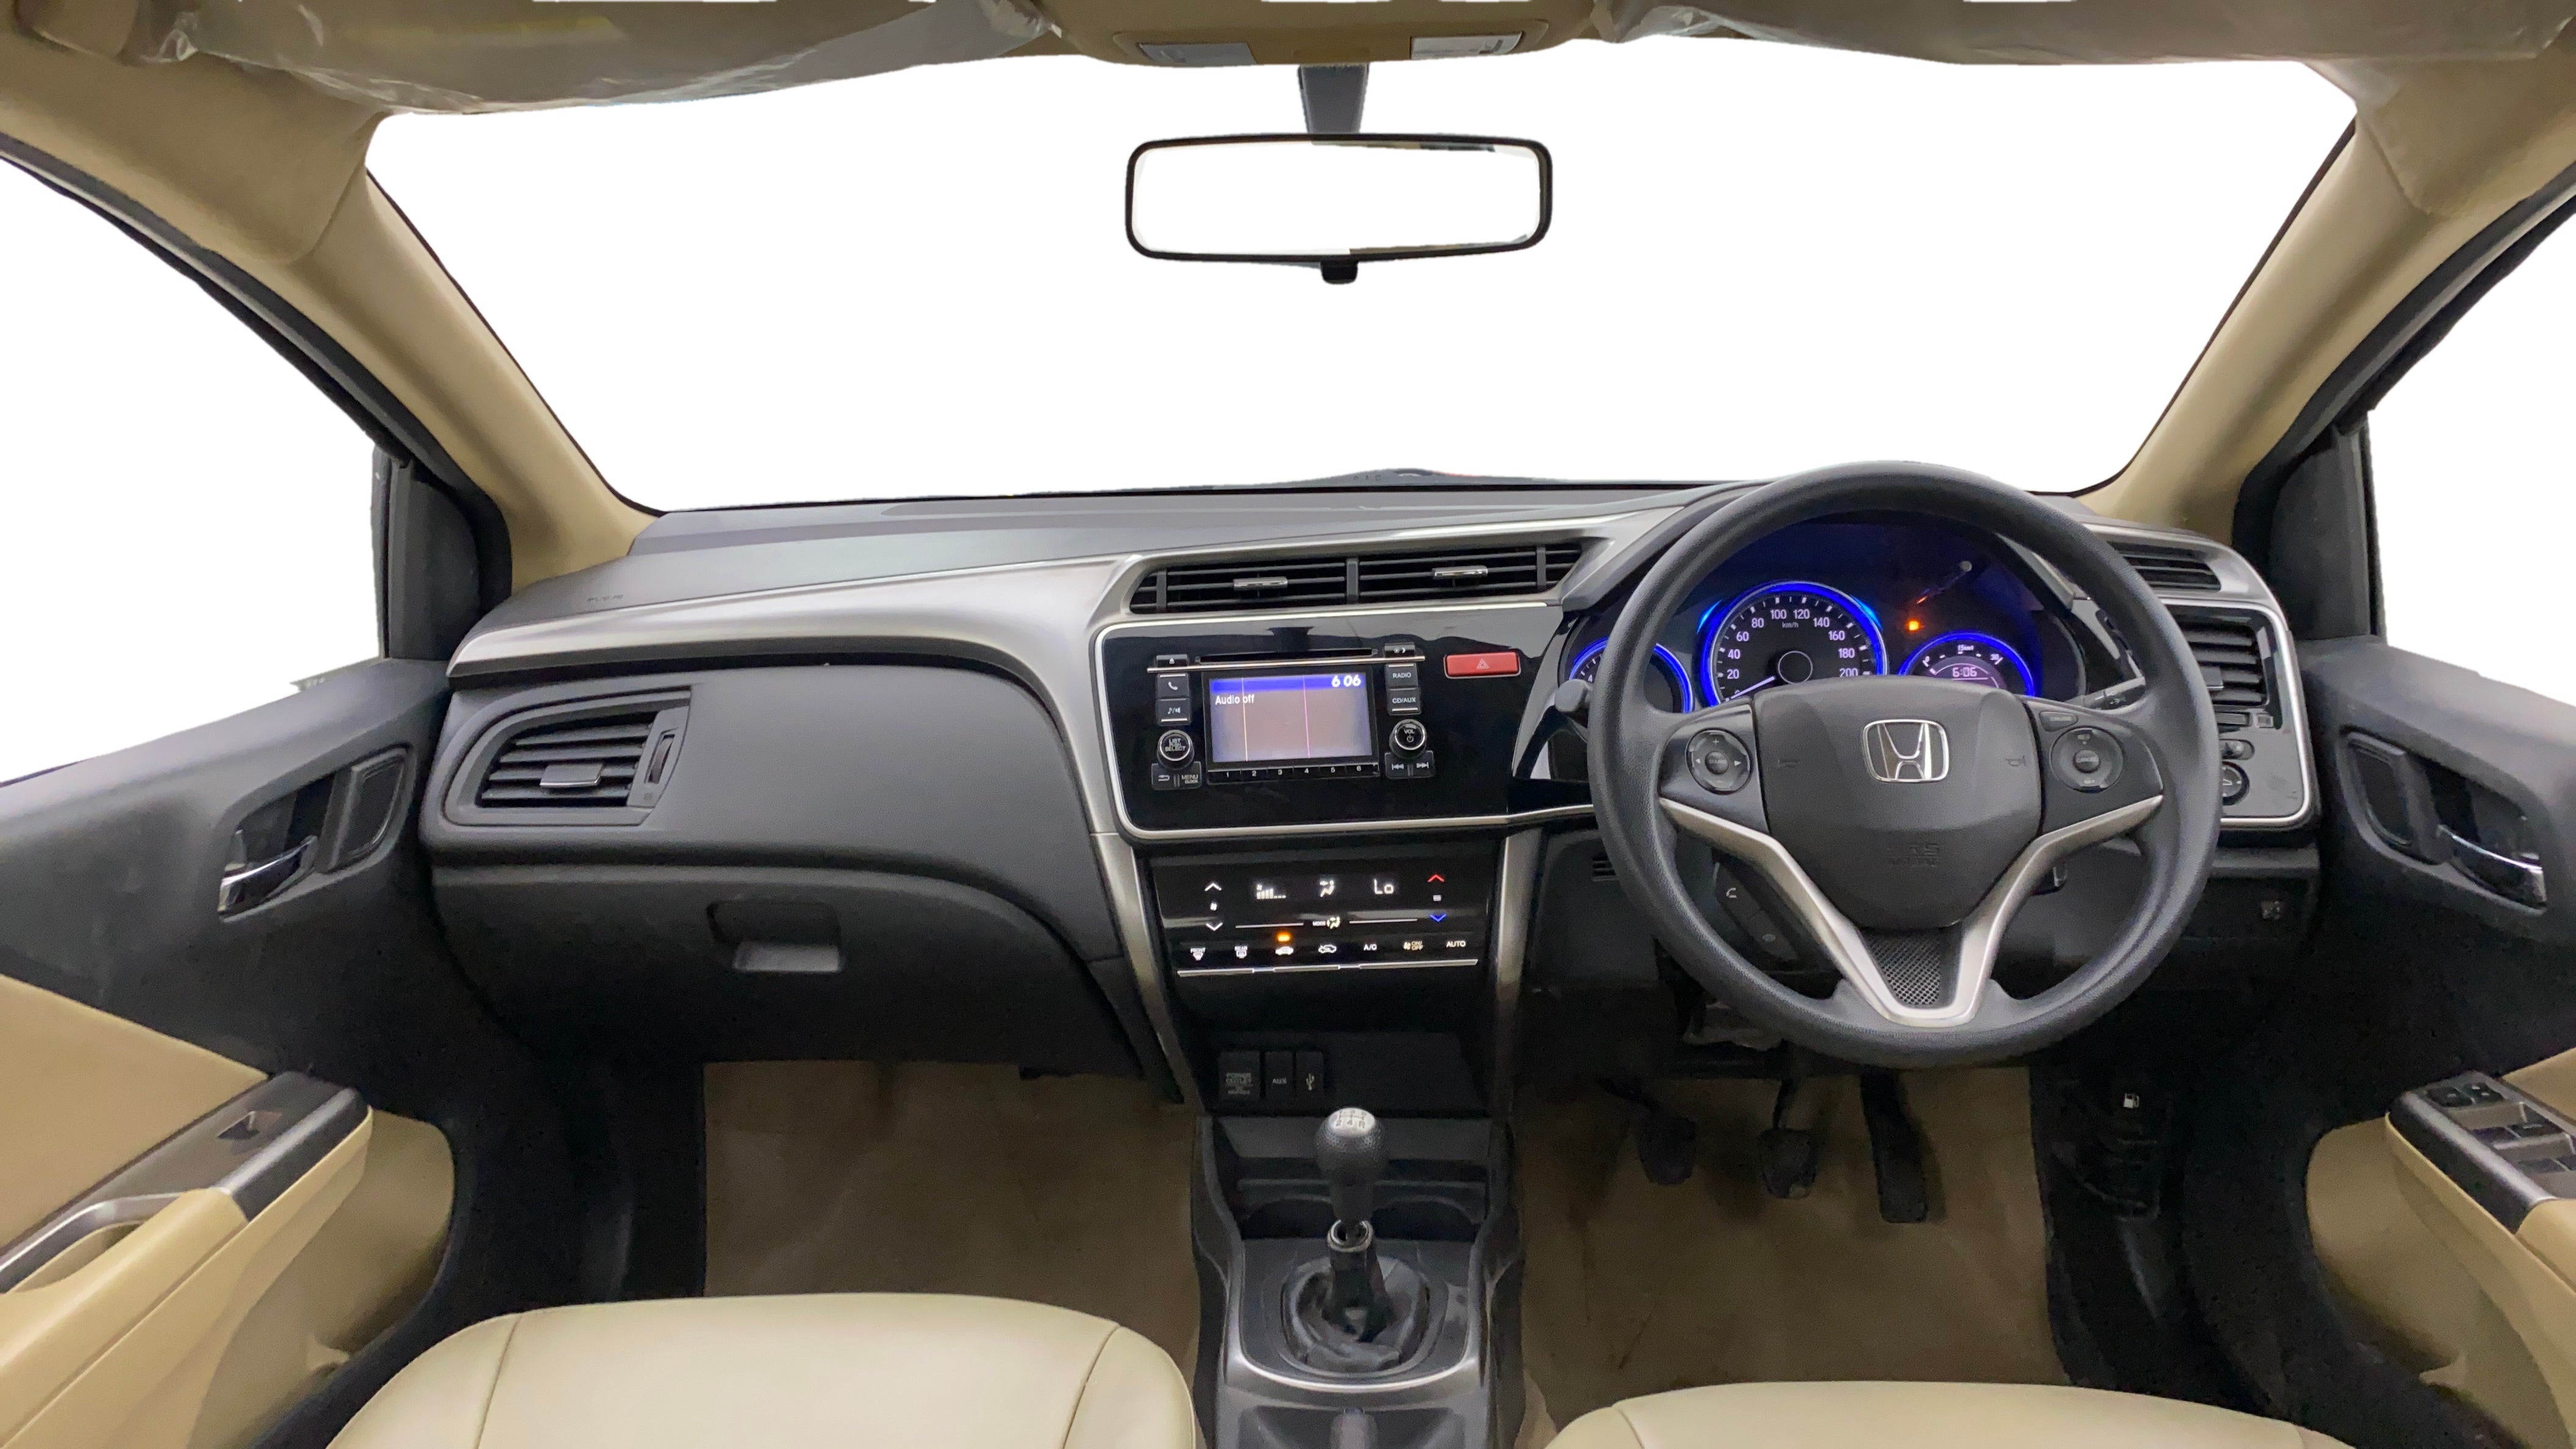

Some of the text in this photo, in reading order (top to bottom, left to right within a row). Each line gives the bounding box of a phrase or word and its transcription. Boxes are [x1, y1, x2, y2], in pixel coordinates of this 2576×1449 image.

[1770, 609, 1787, 620] 100
[1794, 609, 1810, 620] 120
[1751, 618, 1764, 628] 80
[1813, 617, 1830, 628] 140
[1736, 631, 1749, 642] 60
[1828, 630, 1845, 641] 160
[1727, 649, 1741, 660] 40
[1838, 648, 1855, 659] 180
[1587, 674, 1593, 682] 4
[1726, 668, 1739, 679] 20
[1839, 668, 1858, 677] 200
[1952, 667, 1977, 678] 6:06
[1215, 693, 1254, 705] Audio off
[1373, 878, 1395, 895] Lo
[1446, 940, 1466, 948] AUTO
